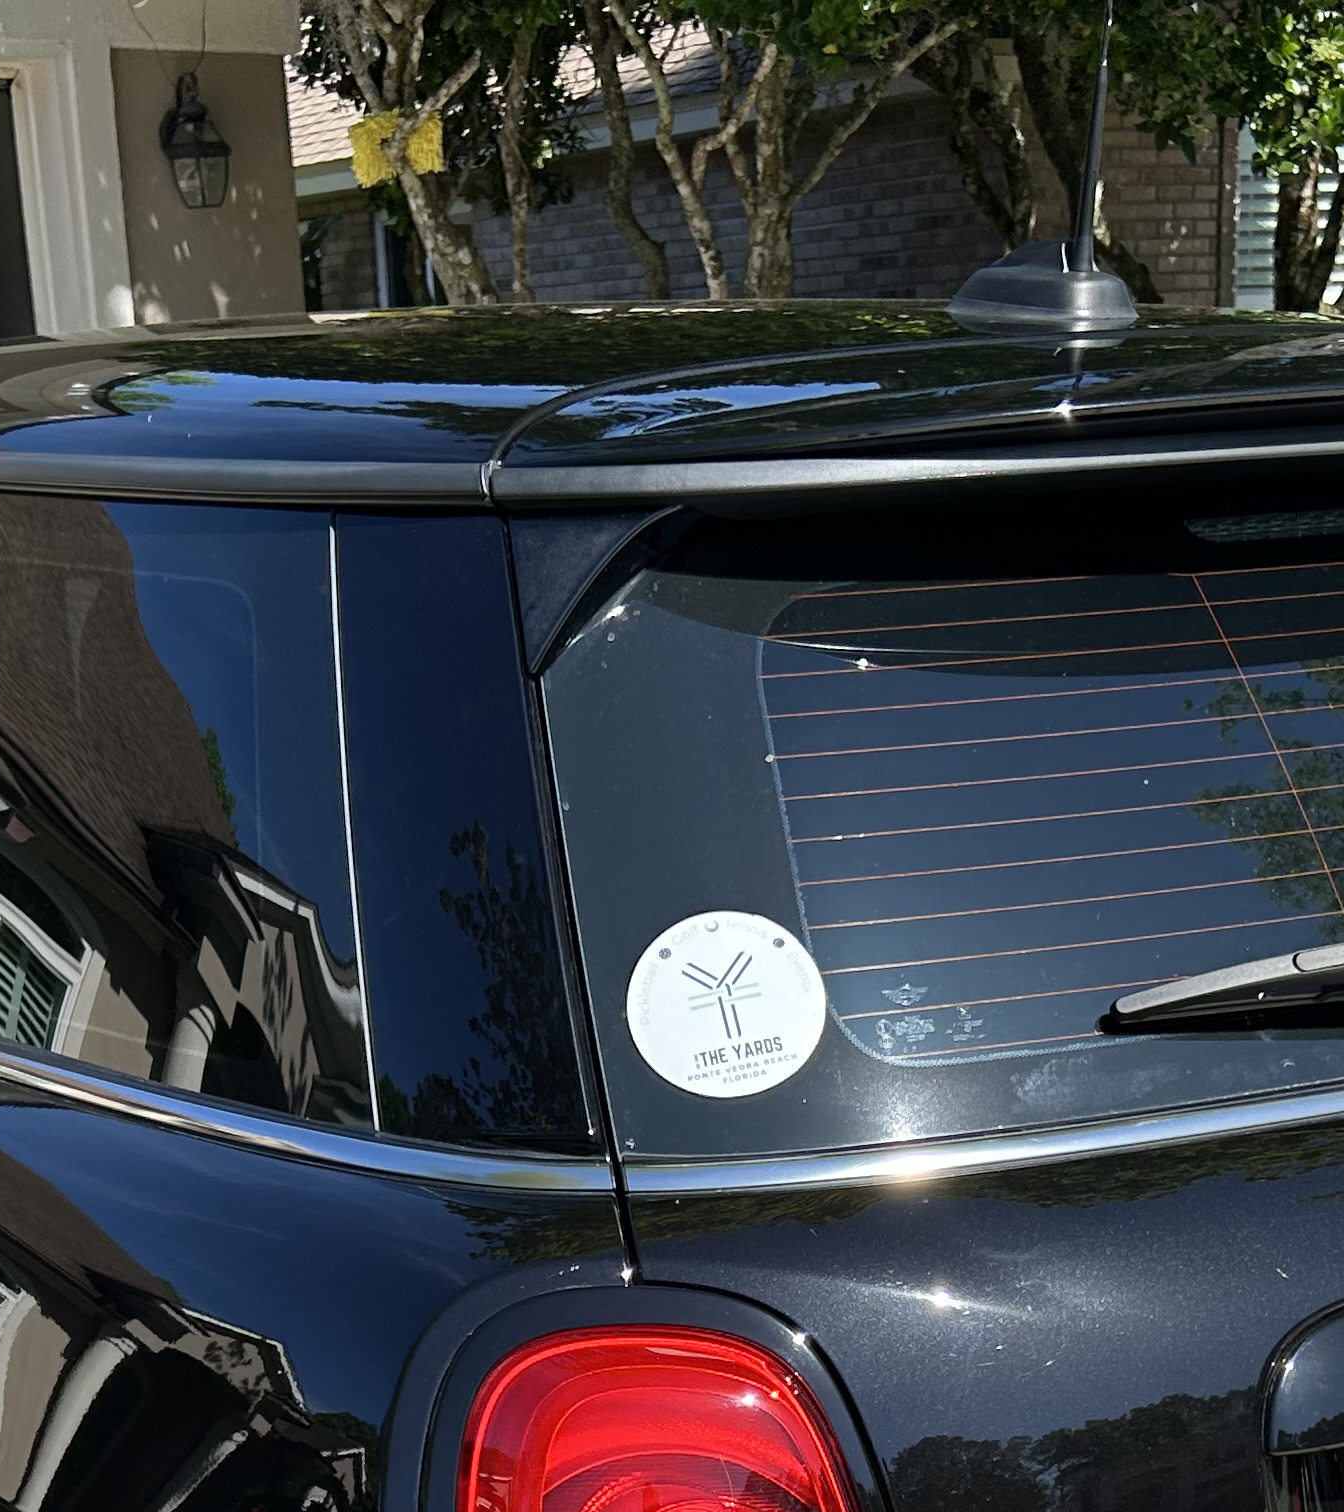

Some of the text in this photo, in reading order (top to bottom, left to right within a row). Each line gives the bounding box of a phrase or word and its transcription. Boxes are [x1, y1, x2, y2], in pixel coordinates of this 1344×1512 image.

[725, 919, 769, 941] Tennis
[698, 1047, 729, 1067] THE
[731, 1036, 783, 1060] YARDS
[687, 1053, 798, 1082] PONTE VEDRA BEACH
[722, 1069, 768, 1085] FLORIDA
